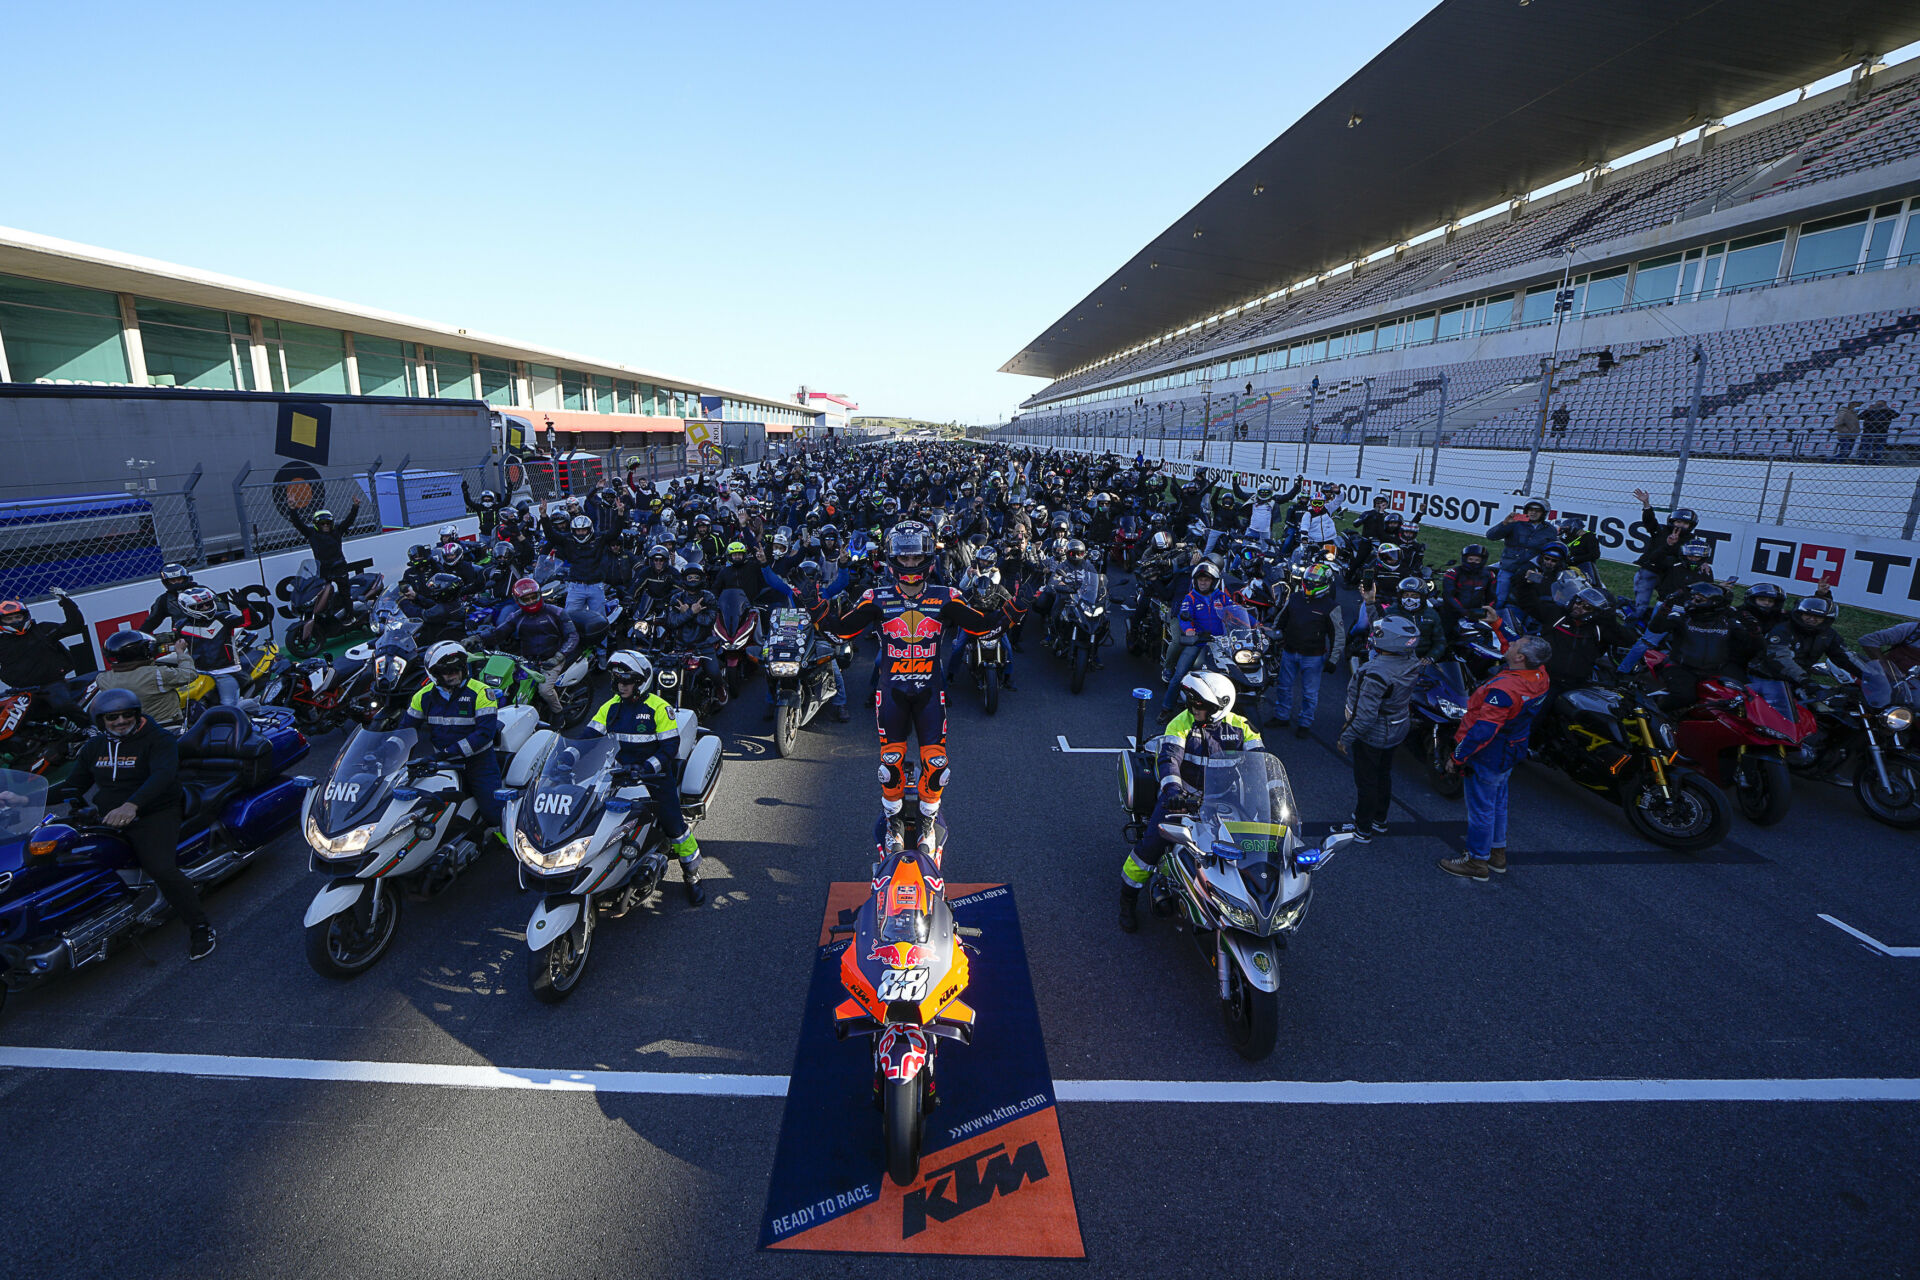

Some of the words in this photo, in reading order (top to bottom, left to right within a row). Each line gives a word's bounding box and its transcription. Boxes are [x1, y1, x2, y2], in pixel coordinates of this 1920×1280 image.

[1169, 463, 1191, 476] TISSOT
[1561, 511, 1732, 565] TISST
[887, 642, 912, 658] Red
[912, 642, 937, 659] Bull
[890, 658, 934, 673] KTM
[324, 782, 361, 803] GNR
[534, 792, 573, 816] GNR
[1241, 839, 1278, 853] GNR
[850, 984, 871, 1005] KTM
[877, 966, 930, 1002] 88
[939, 983, 958, 1006] KTM
[960, 1092, 1048, 1134] www.ktm.com
[903, 1140, 1050, 1240] KTM
[772, 1205, 815, 1236] READY
[817, 1198, 836, 1216] TO
[836, 1184, 873, 1209] RACE
